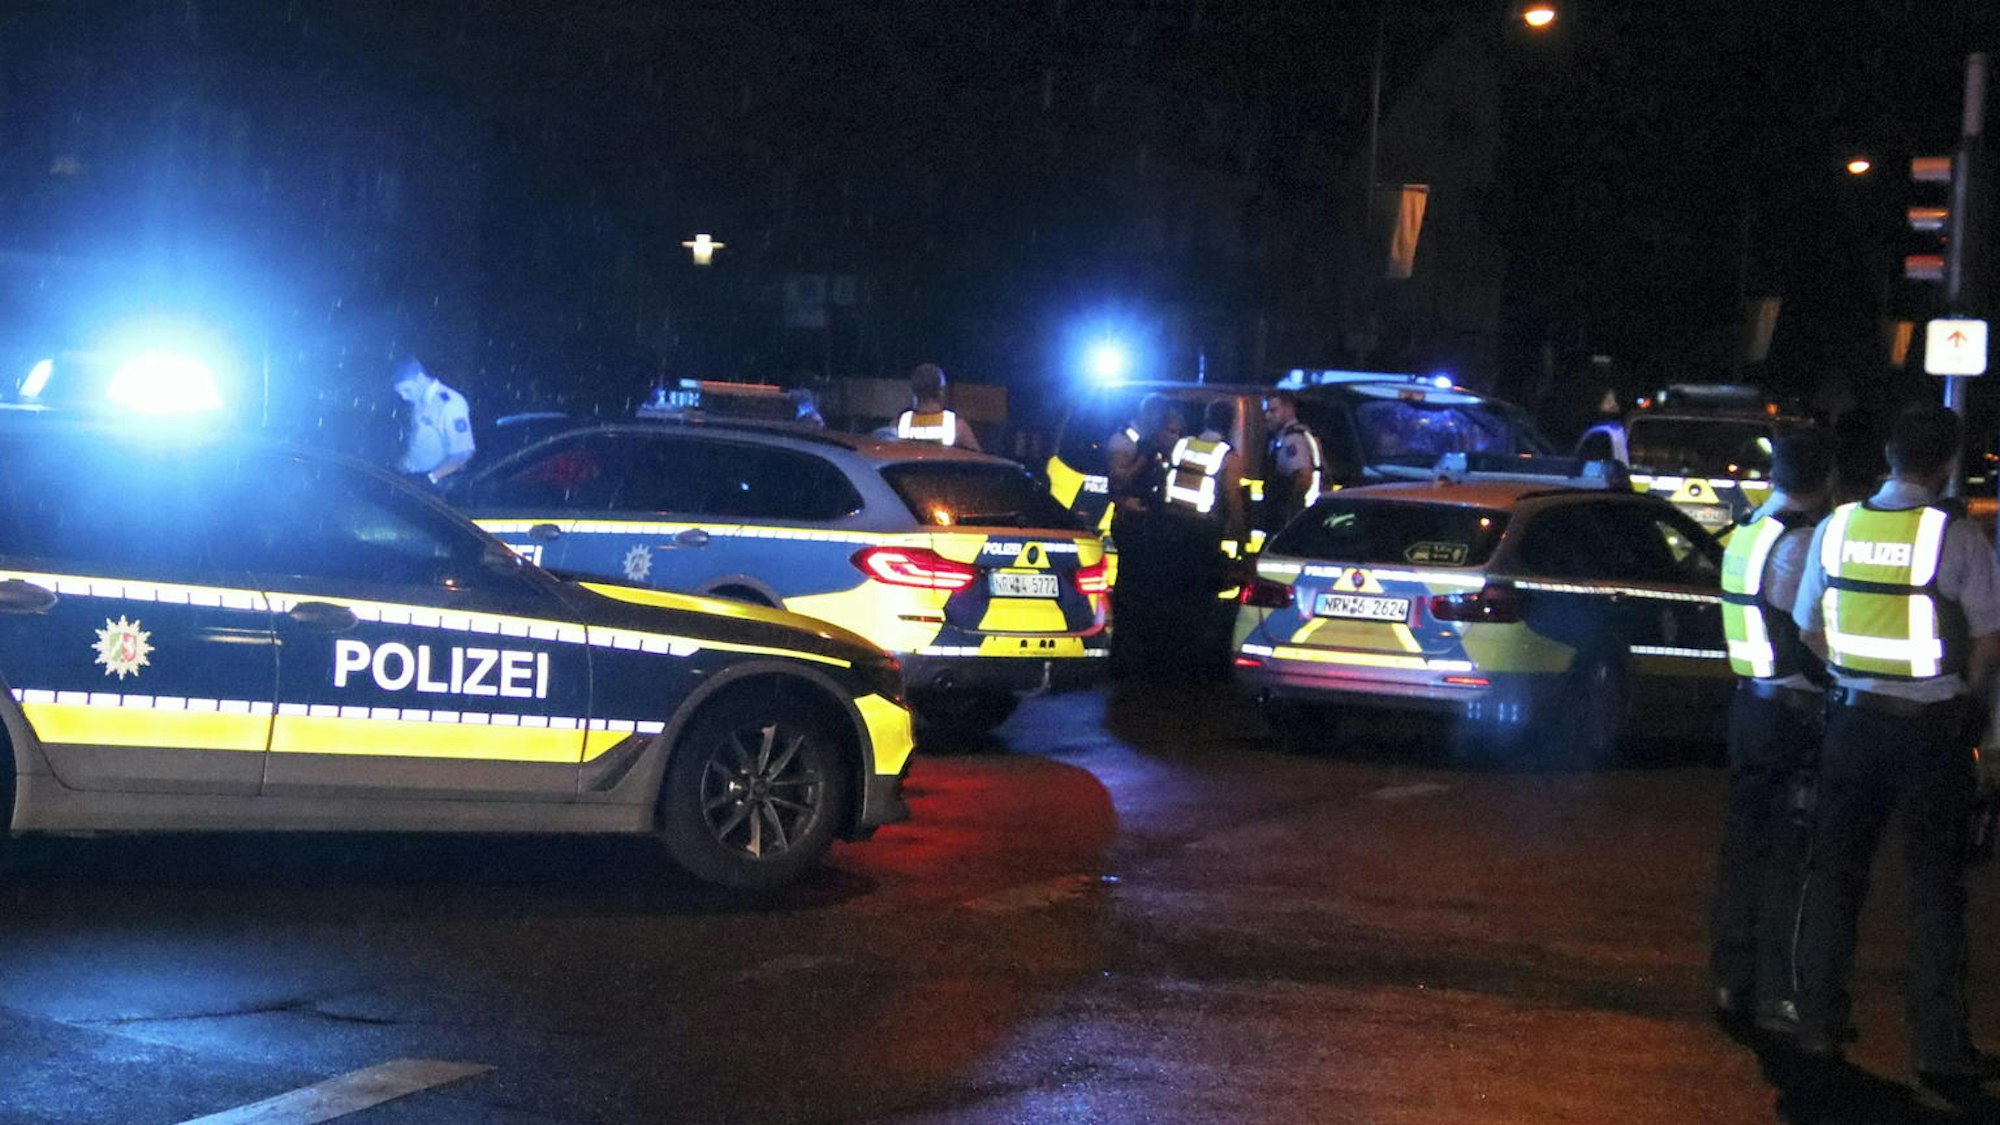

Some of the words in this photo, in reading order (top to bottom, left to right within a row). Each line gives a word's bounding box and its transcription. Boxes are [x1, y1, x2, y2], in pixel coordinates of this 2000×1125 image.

[983, 542, 1022, 556] POLIZEI
[1842, 541, 1911, 566] POLIZEI
[333, 639, 549, 699] POLIZEI
